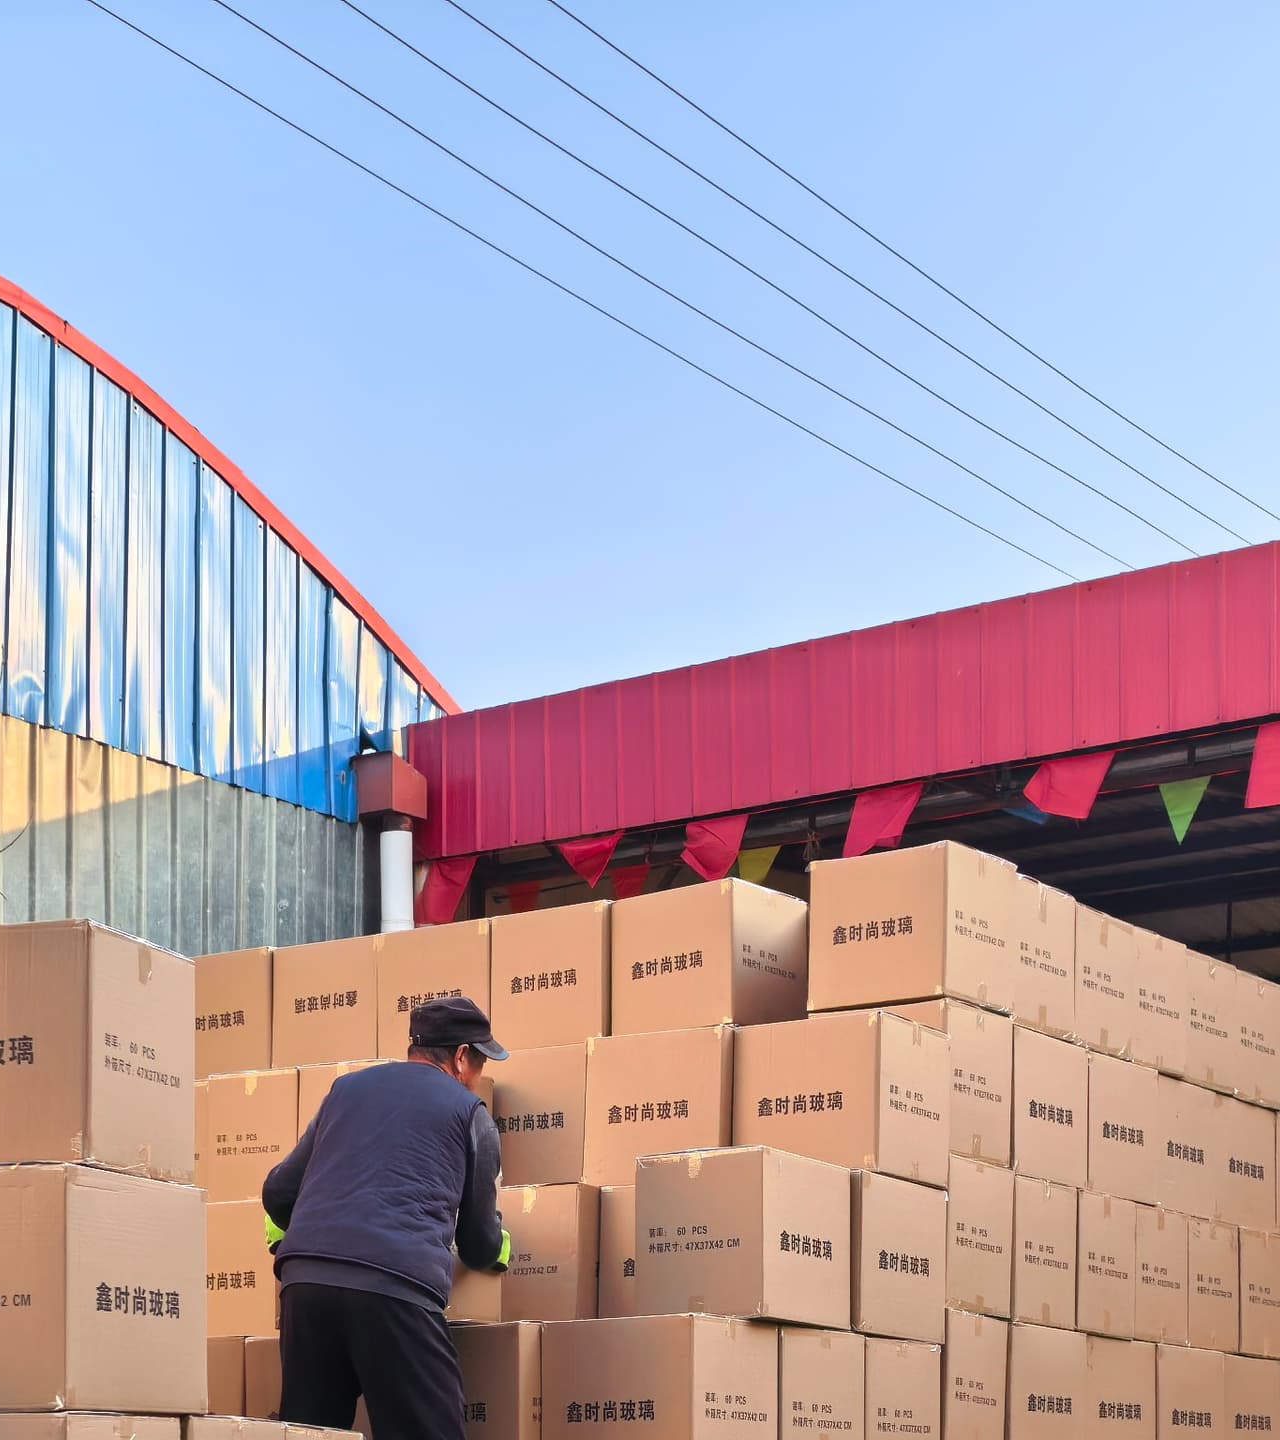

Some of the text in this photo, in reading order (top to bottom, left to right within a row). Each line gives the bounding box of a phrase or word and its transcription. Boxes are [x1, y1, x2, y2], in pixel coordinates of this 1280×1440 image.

[833, 915, 913, 945] 鑫时尚玻璃
[631, 950, 703, 980] 鑫时尚玻璃
[510, 968, 577, 994] 鑫时尚玻璃
[129, 1042, 156, 1060] 60 PCS
[170, 1075, 181, 1089] CM
[608, 1100, 689, 1125] 鑫时尚玻璃
[757, 1090, 843, 1117] 鑫时尚玻璃
[1029, 1099, 1073, 1128] 鑫时尚玻璃
[677, 1226, 686, 1236] 60
[692, 1225, 708, 1235] PCS
[727, 1237, 740, 1248] CM
[779, 1229, 833, 1262] 鑫时尚玻璃
[878, 1249, 930, 1278] 鑫时尚玻璃
[12, 1293, 32, 1307] CM
[96, 1282, 180, 1319] 鑫时尚玻璃
[566, 1399, 655, 1424] 鑫时尚玻璃
[735, 1395, 747, 1406] PCS
[821, 1404, 833, 1414] PCS
[1028, 1393, 1072, 1415] 鑫时尚玻璃
[903, 1409, 913, 1419] PCS
